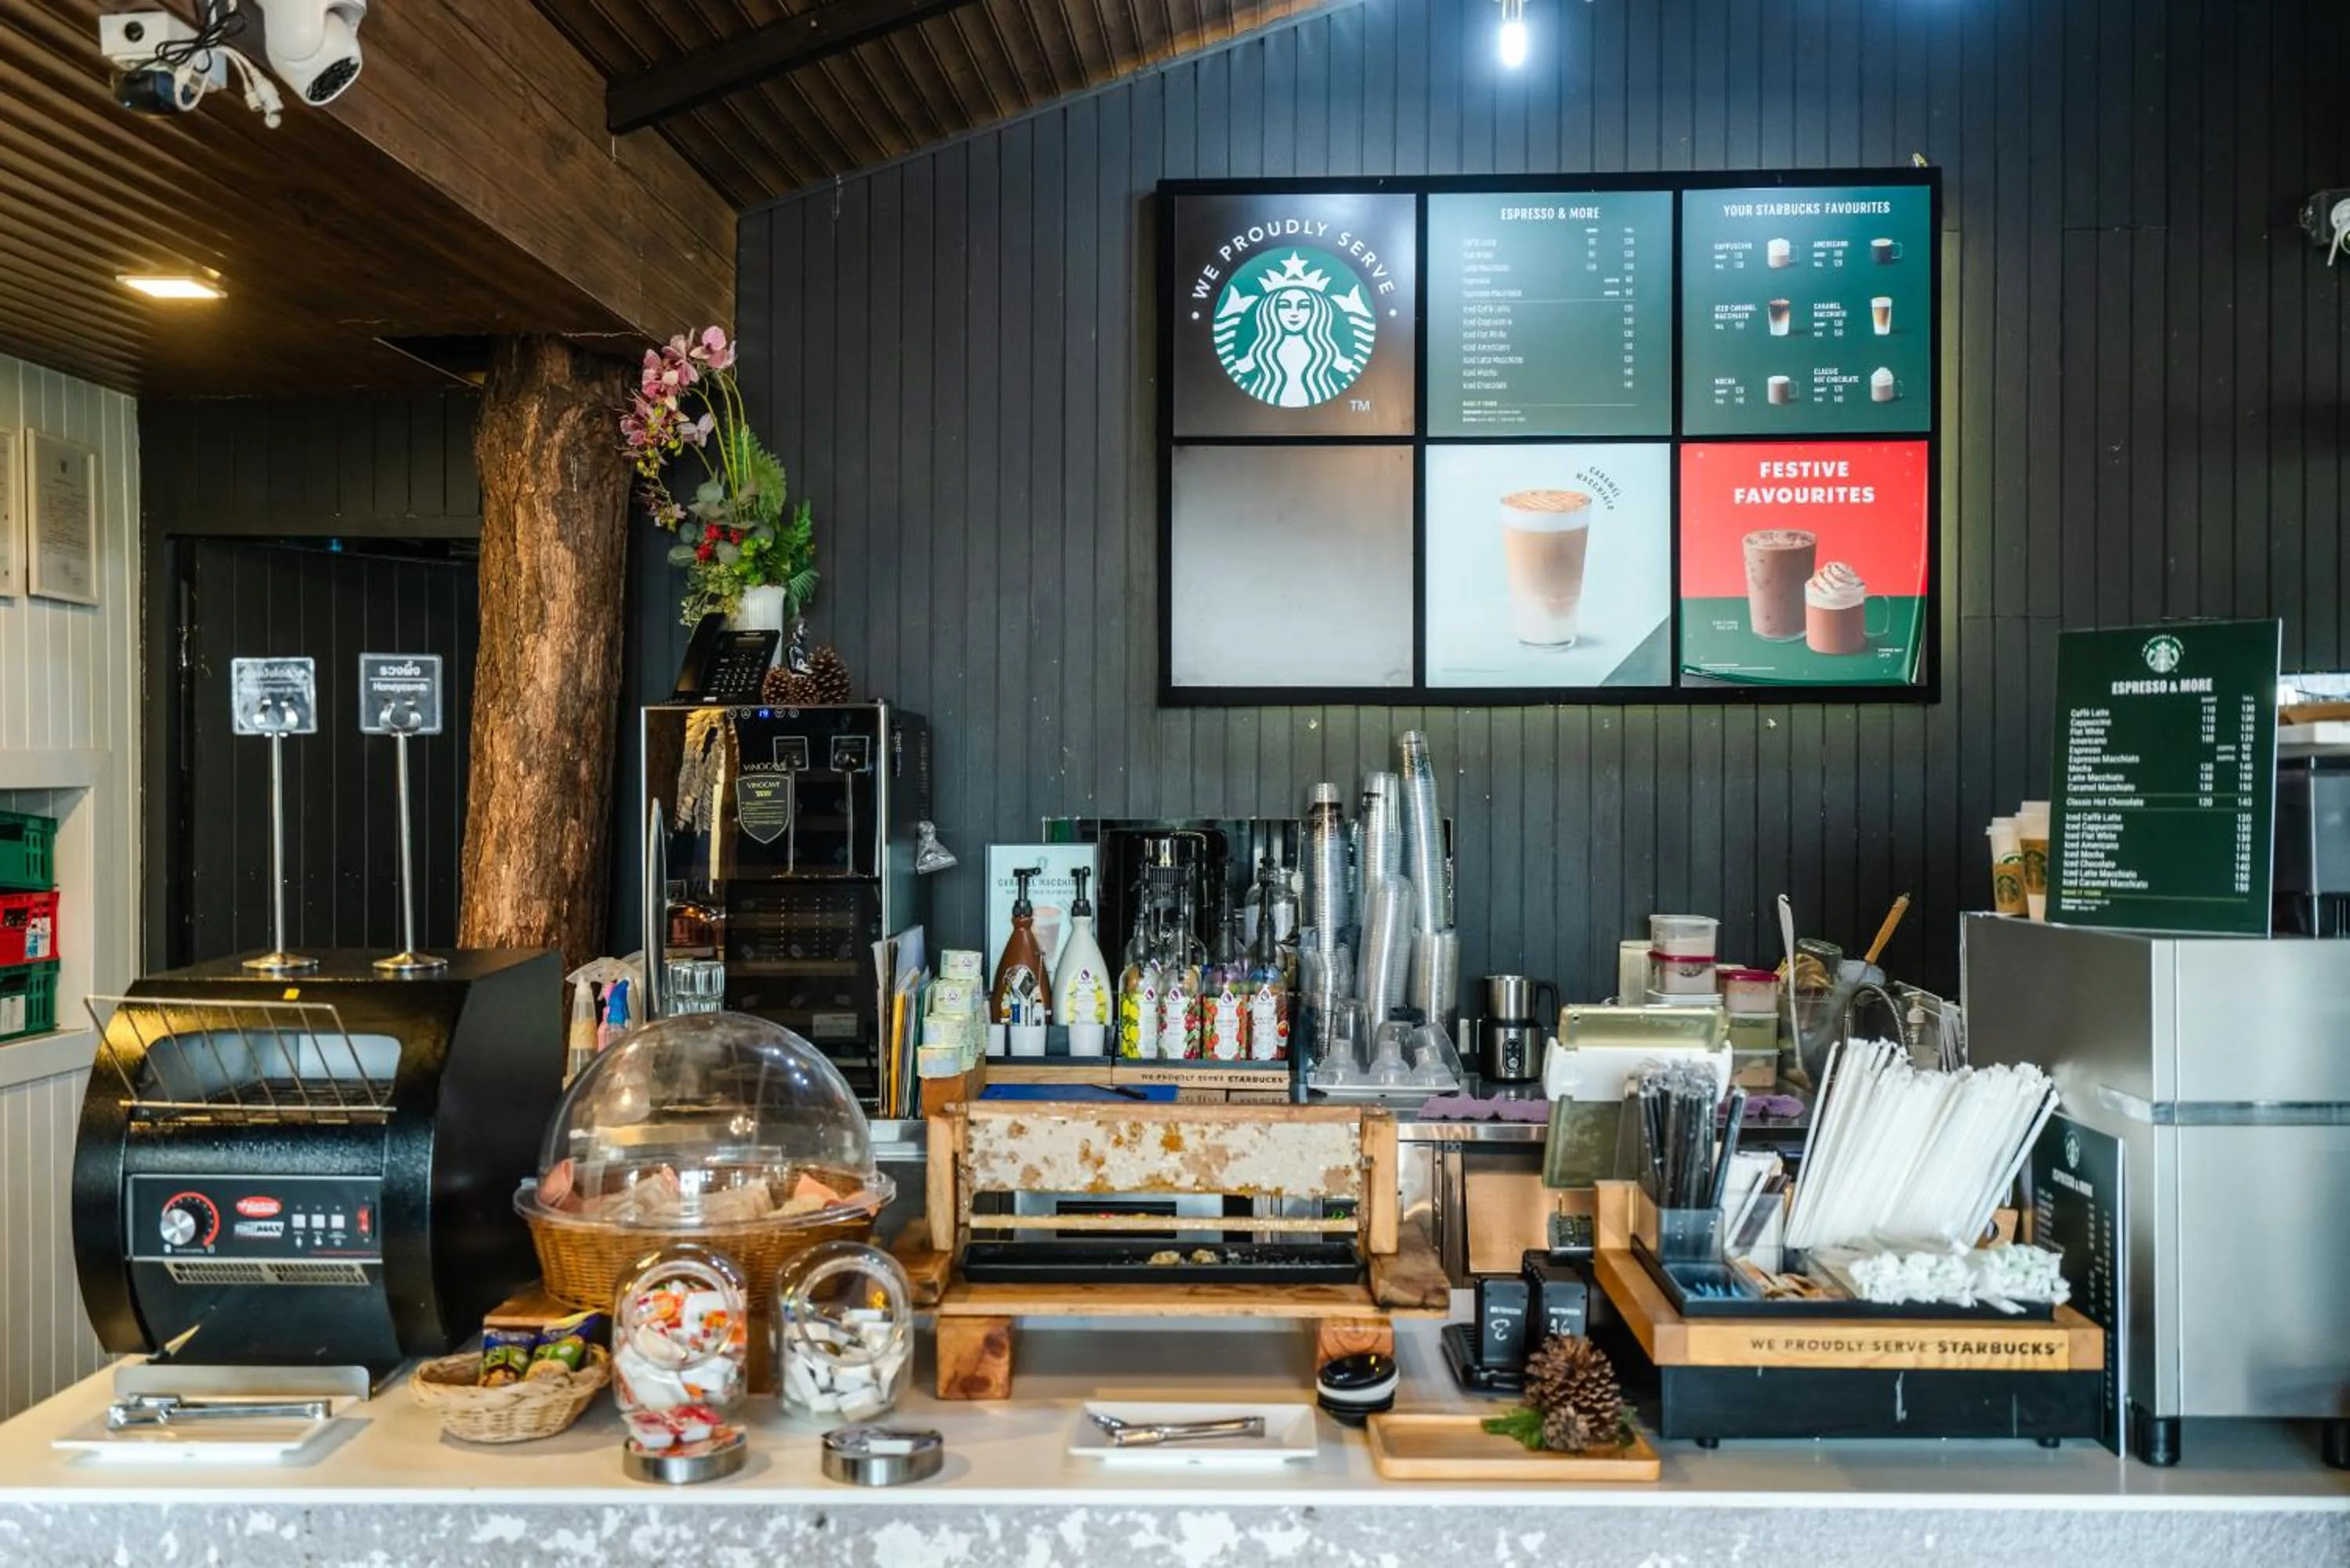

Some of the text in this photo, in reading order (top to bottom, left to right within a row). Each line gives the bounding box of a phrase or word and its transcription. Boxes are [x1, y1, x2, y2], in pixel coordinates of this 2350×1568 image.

[1501, 207, 1600, 220] ESPRESSO & MORE
[1723, 201, 1890, 217] YOUR STARBUCKS FAVOURITES
[1192, 219, 1394, 299] WE PROUDLY SERVE
[1350, 400, 1371, 411] TM
[1760, 461, 1849, 478] FESTIVE
[1734, 487, 1875, 504] FAVOURITES
[2112, 677, 2213, 695] ESPRESSO & MORE
[998, 878, 1038, 887] CARAEL
[1227, 1075, 1283, 1084] STARBUCKS
[1751, 1339, 2056, 1356] WE PROUDLY SERVE STARBUCKS
